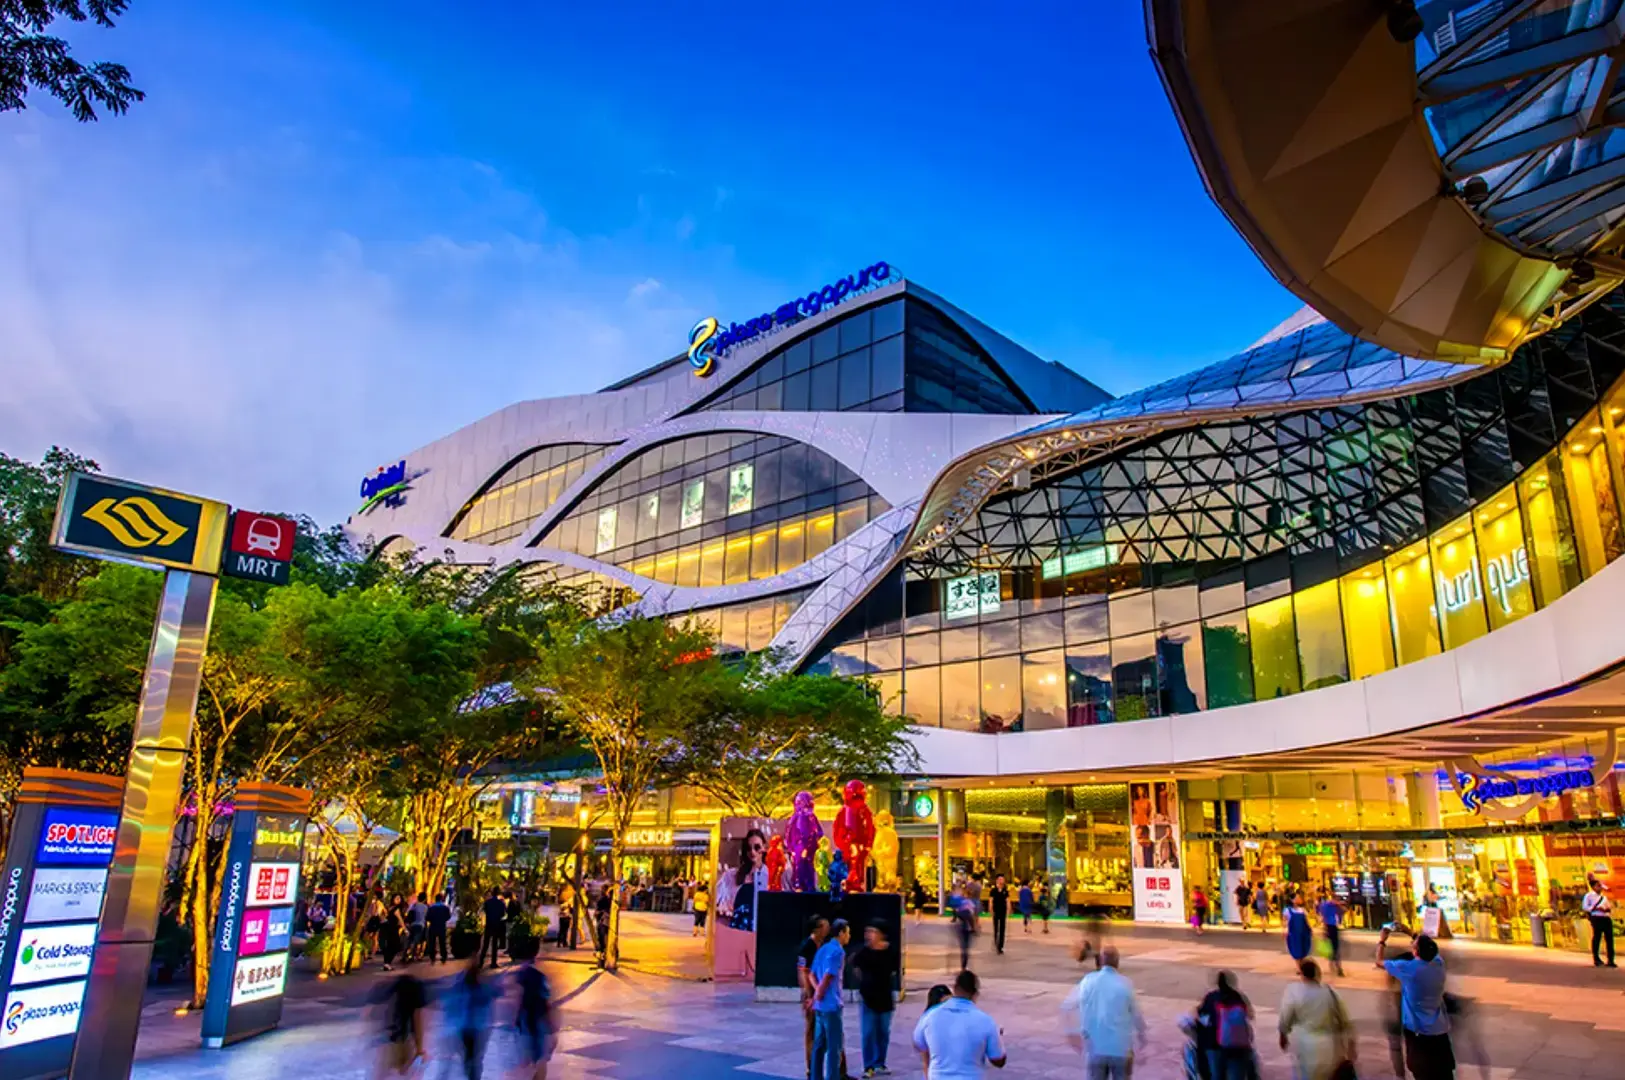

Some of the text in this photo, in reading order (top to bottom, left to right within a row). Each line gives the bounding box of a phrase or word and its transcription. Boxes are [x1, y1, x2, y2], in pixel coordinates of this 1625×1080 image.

[716, 261, 890, 356] plaza singapura
[236, 554, 282, 578] MRT
[1430, 543, 1531, 617] Jurlque
[1478, 769, 1595, 804] plaza singapura
[220, 861, 242, 952] plaza singapura
[37, 944, 62, 960] Cold
[21, 1007, 48, 1025] plaza
